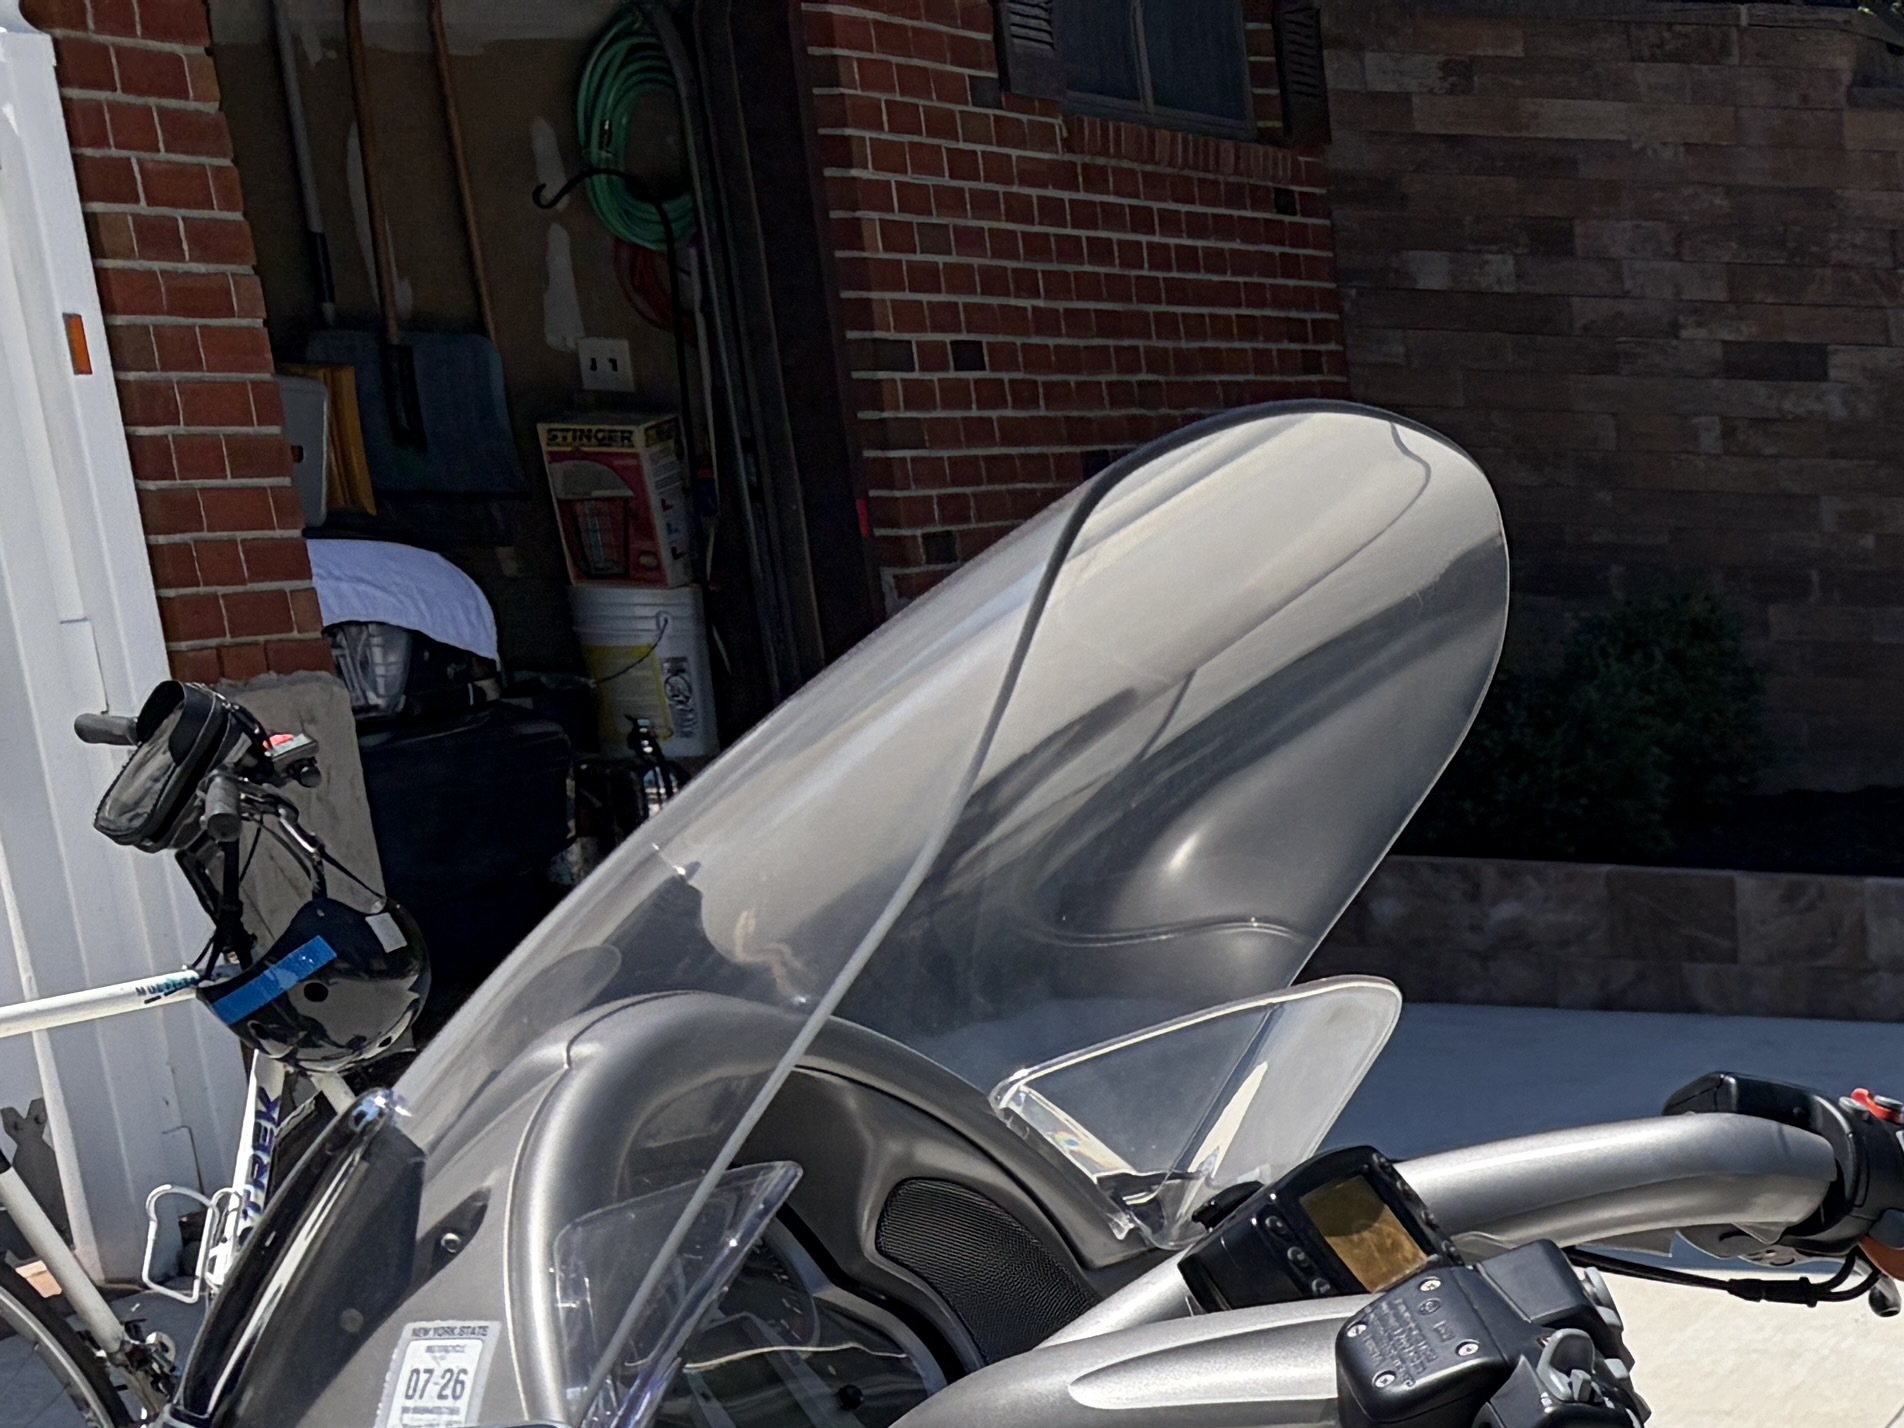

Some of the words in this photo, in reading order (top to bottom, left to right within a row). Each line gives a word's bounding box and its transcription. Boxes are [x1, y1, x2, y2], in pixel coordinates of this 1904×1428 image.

[546, 428, 634, 443] STINGER
[411, 1327, 432, 1337] NEW
[433, 1326, 458, 1337] YORK
[459, 1325, 490, 1337] STATE
[404, 1367, 469, 1401] 07-26
